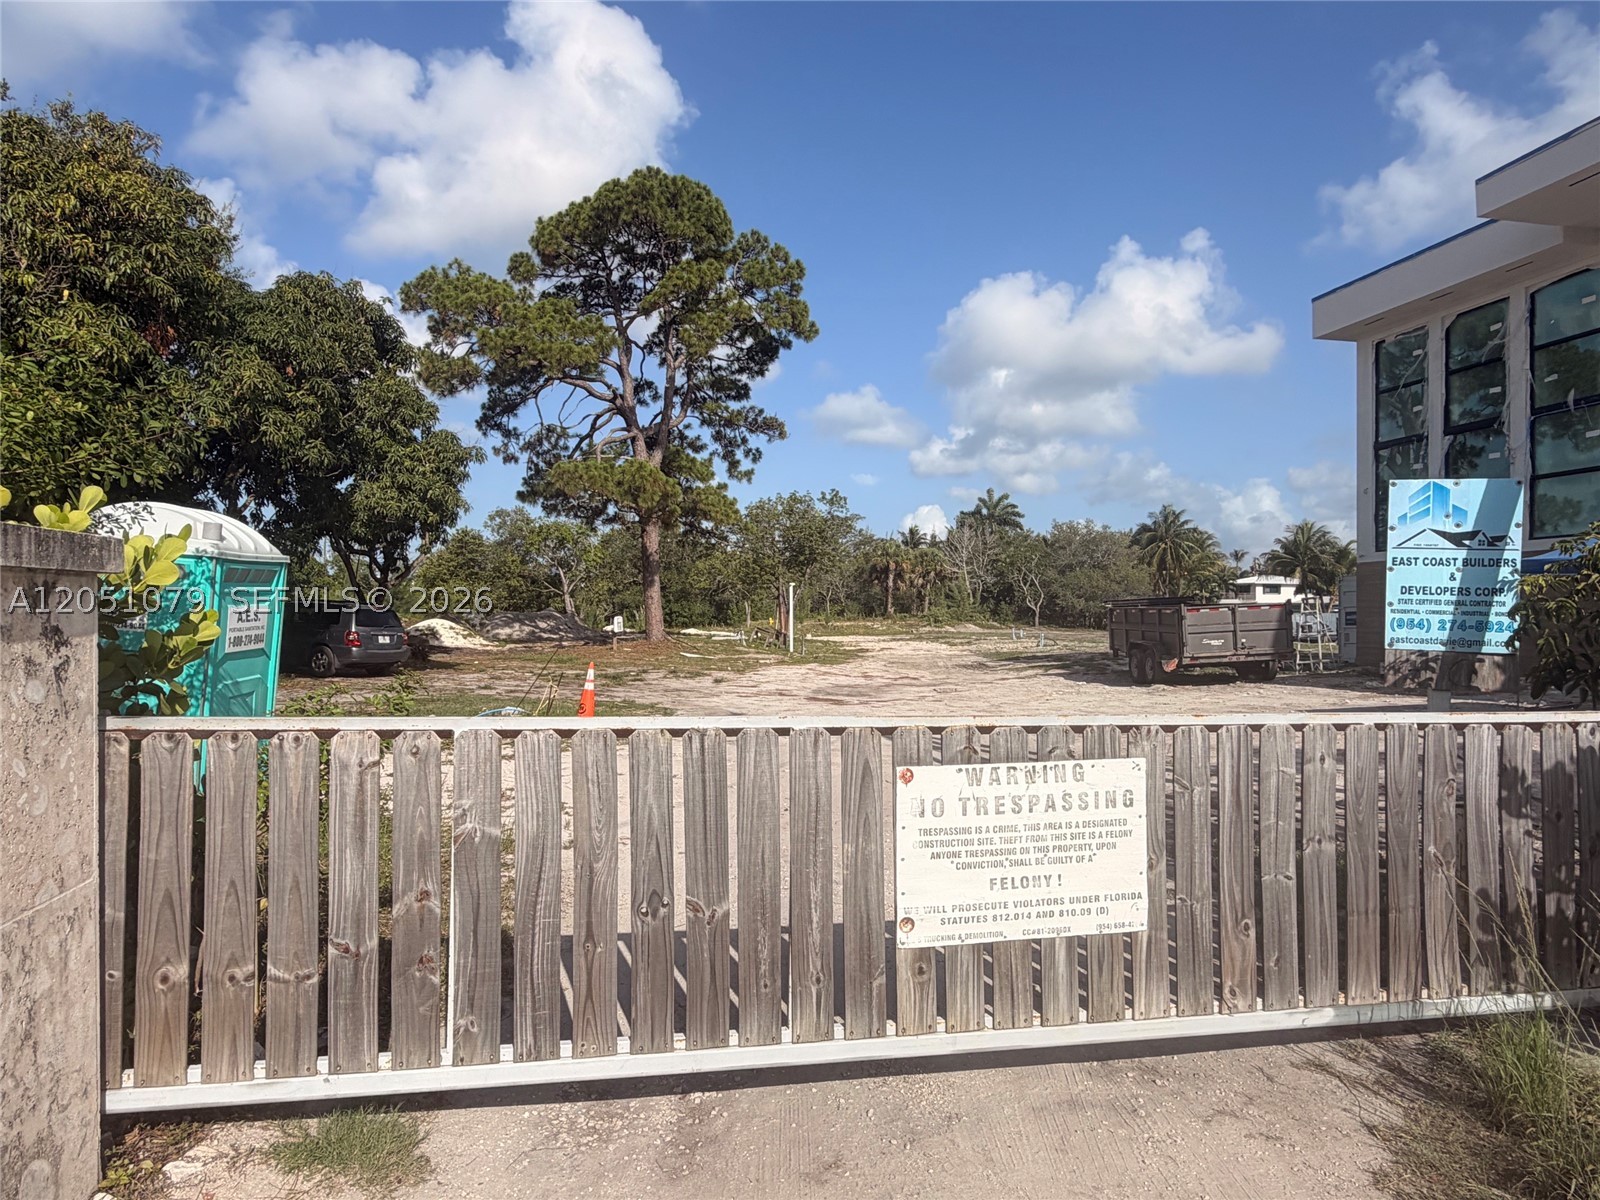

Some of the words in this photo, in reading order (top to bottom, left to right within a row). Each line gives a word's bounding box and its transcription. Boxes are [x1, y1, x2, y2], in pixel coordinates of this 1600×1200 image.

[1391, 556, 1420, 567] EAST
[1422, 556, 1459, 567] COAST
[1461, 557, 1518, 568] BUILDERS
[1448, 571, 1457, 582] &
[1400, 585, 1472, 597] DEVELOPERS
[1474, 587, 1507, 598] CORP.
[1397, 598, 1414, 606] STATE
[1414, 598, 1442, 606] CERTIFIED
[1443, 599, 1468, 607] GENERAL
[1389, 617, 1432, 634] (954)
[1437, 618, 1516, 634] 274-5924
[964, 762, 1085, 787] WARNING
[910, 796, 945, 818] NO
[958, 788, 1134, 817] TRESPASSING
[918, 826, 973, 837] TRESPASSING
[975, 826, 983, 834] IS
[984, 825, 991, 834] A
[992, 824, 1021, 834] CRIME,
[1023, 822, 1041, 832] THIS
[1042, 821, 1063, 831] AREA
[1065, 820, 1073, 830] IS
[1074, 820, 1080, 829] A
[1082, 818, 1128, 829] DESIGNATED
[912, 838, 975, 850] CONSTRUCTION
[976, 836, 997, 846] SITE.
[999, 835, 1024, 845] THEFT
[1025, 834, 1048, 844] FROM
[1050, 832, 1068, 842] THIS
[1069, 832, 1086, 841] SITE
[1088, 831, 1096, 840] IS
[1098, 830, 1104, 839] A
[1105, 828, 1133, 839] FELONY
[930, 850, 962, 860] ANYONE
[964, 847, 1018, 858] TRESPASSING
[1019, 846, 1031, 856] ON
[1032, 845, 1050, 854] THIS
[1052, 842, 1094, 854] PROPERTY,
[1095, 842, 1117, 851] UPON
[1008, 858, 1033, 868] SHALL
[1034, 856, 1046, 866] BE
[1047, 855, 1074, 865] GUILTY
[1075, 854, 1086, 864] OF
[1087, 854, 1094, 863] A
[922, 905, 948, 915] WILL
[951, 901, 1009, 913] PROSECUTE
[1012, 896, 1066, 908] VIOLATORS
[1068, 894, 1101, 904] UNDER
[1104, 892, 1144, 902] FLORIDA
[940, 914, 988, 926] STATUTES
[992, 912, 1032, 922] 812.014
[1036, 910, 1055, 919] AND
[1058, 908, 1092, 918] 810.09
[1096, 906, 1110, 916] (D)
[923, 932, 956, 944] TRUCKING
[964, 930, 1004, 940] DEMOLITION
[1096, 922, 1112, 932] (954)
